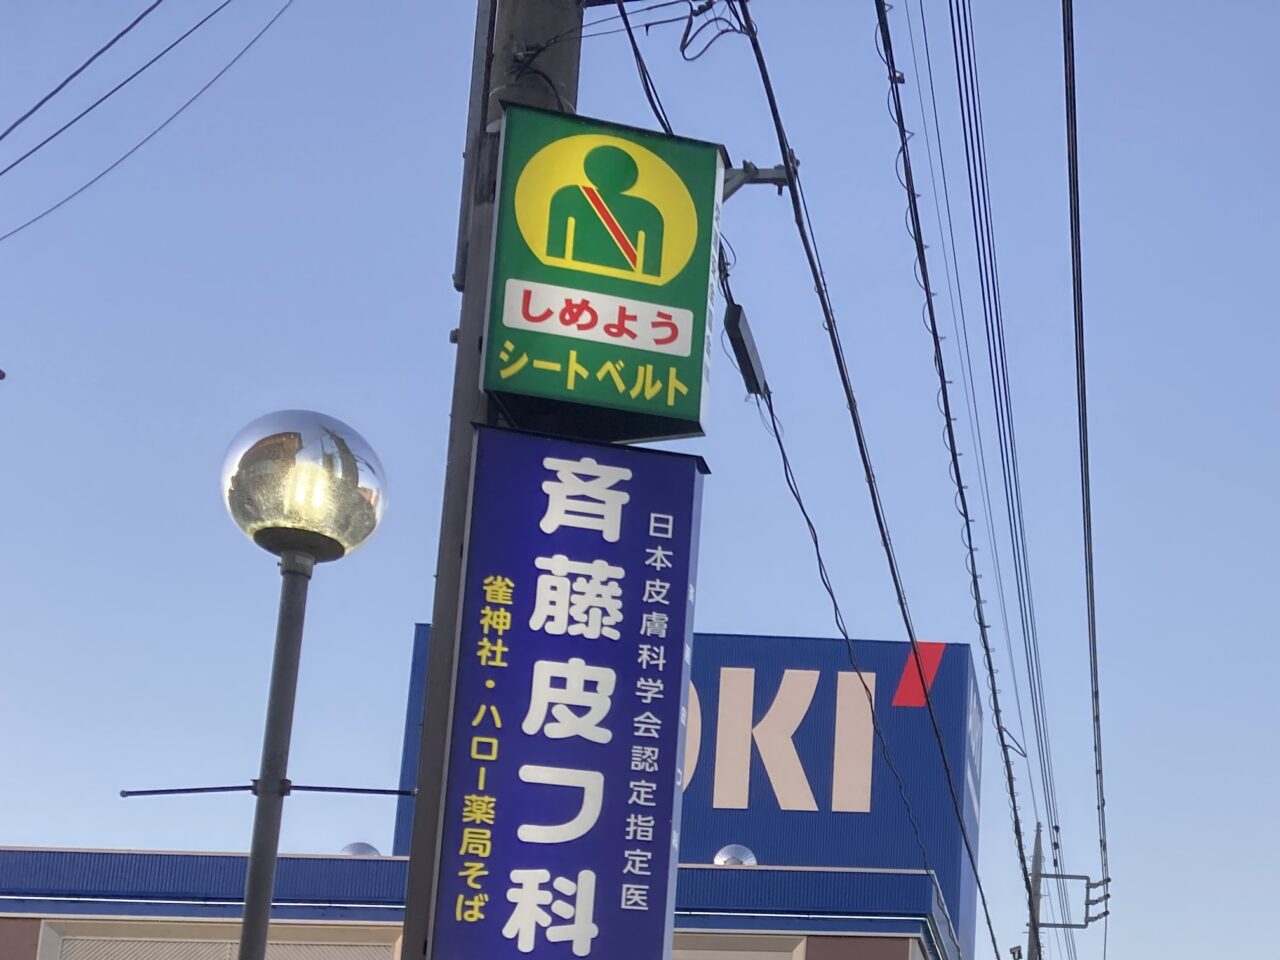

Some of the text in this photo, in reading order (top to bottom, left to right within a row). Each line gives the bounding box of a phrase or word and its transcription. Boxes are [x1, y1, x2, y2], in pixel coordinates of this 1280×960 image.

[499, 340, 689, 406] シートベルト
[521, 289, 679, 345] しめよう
[455, 575, 515, 922] 雀神社・ハロー薬局そば
[502, 457, 633, 957] 斉藤皮フ科
[620, 512, 674, 911] 日本皮膚科学会認定指定医
